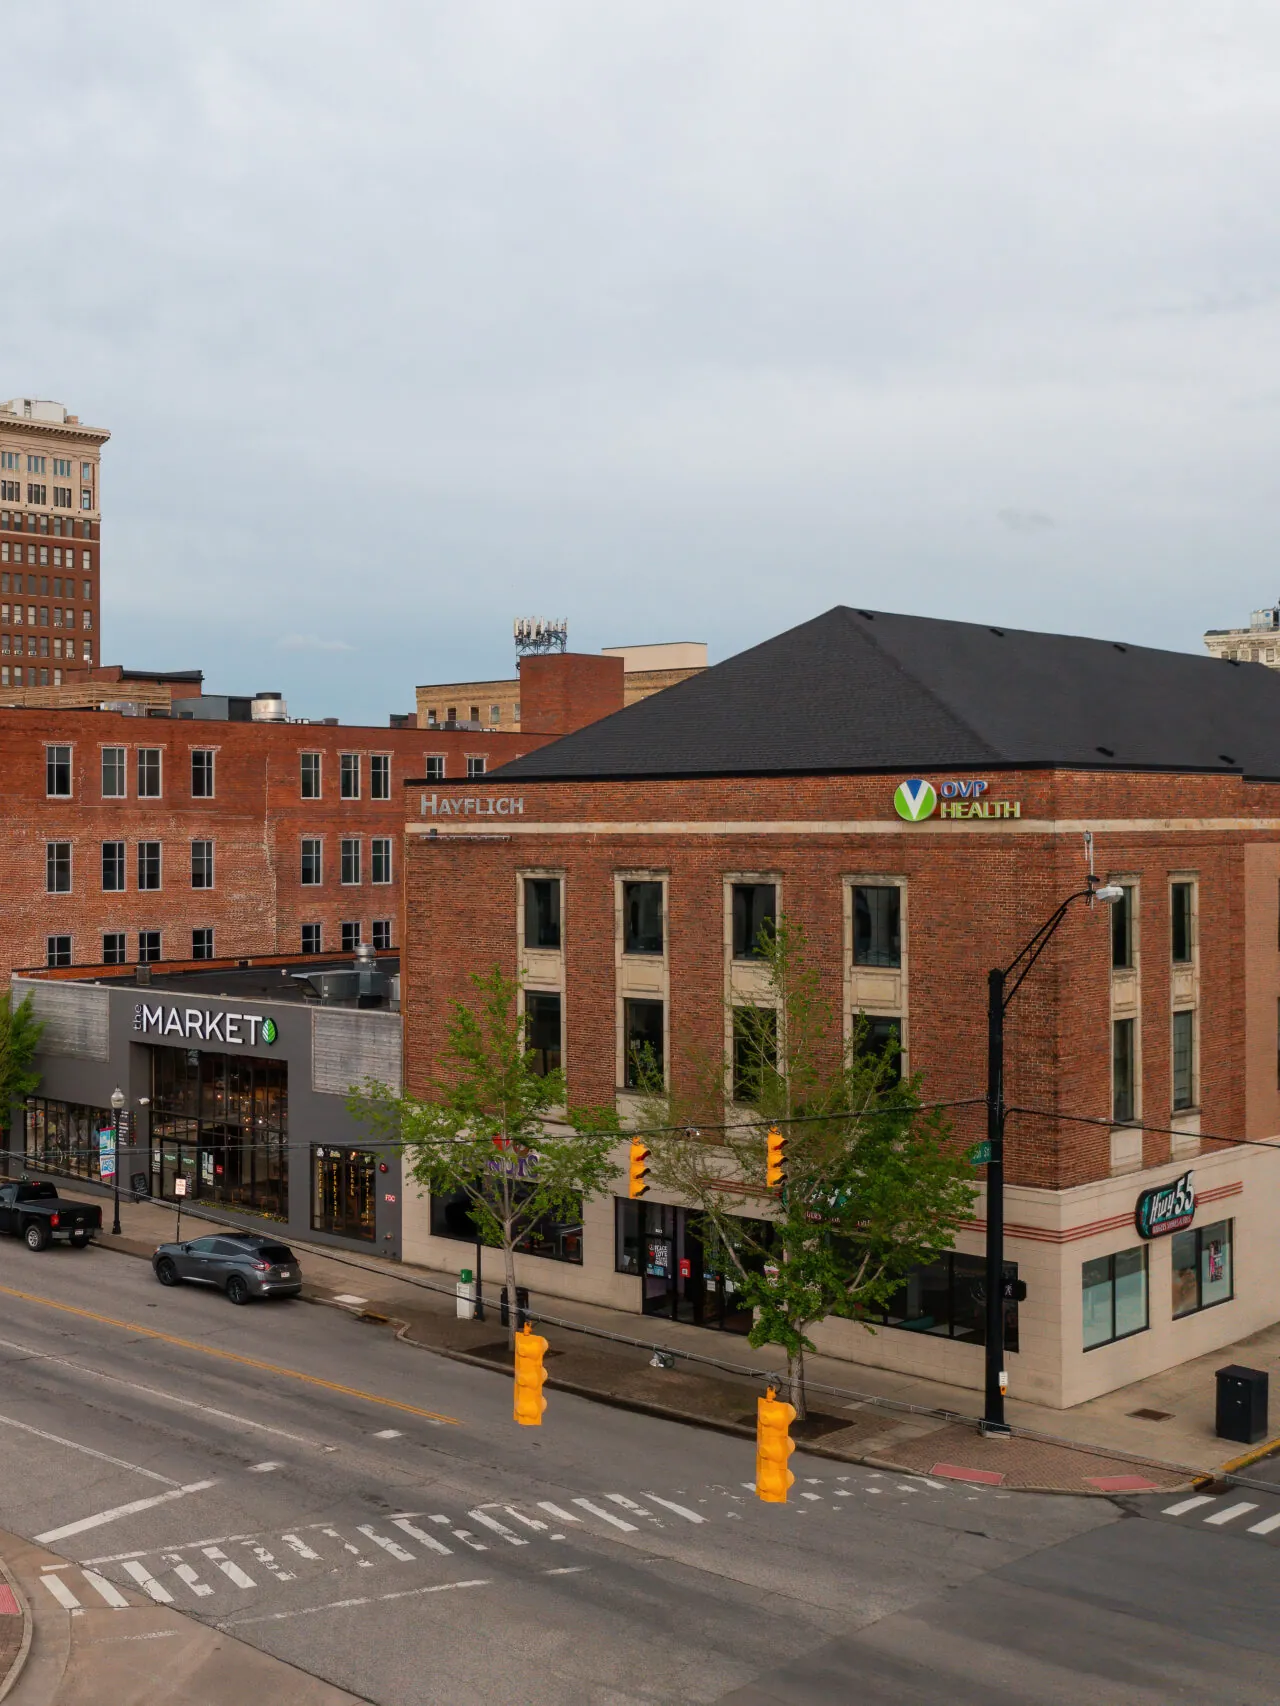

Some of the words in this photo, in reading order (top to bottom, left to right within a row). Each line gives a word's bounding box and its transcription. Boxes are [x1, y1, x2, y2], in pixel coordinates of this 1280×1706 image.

[941, 781, 988, 798] OVP
[420, 793, 524, 815] HAYFLICH
[940, 801, 1021, 819] HEALTH
[132, 1003, 142, 1031] the
[142, 1003, 263, 1046] MARKET
[385, 1193, 396, 1203] FDC
[1175, 1171, 1195, 1215] 55
